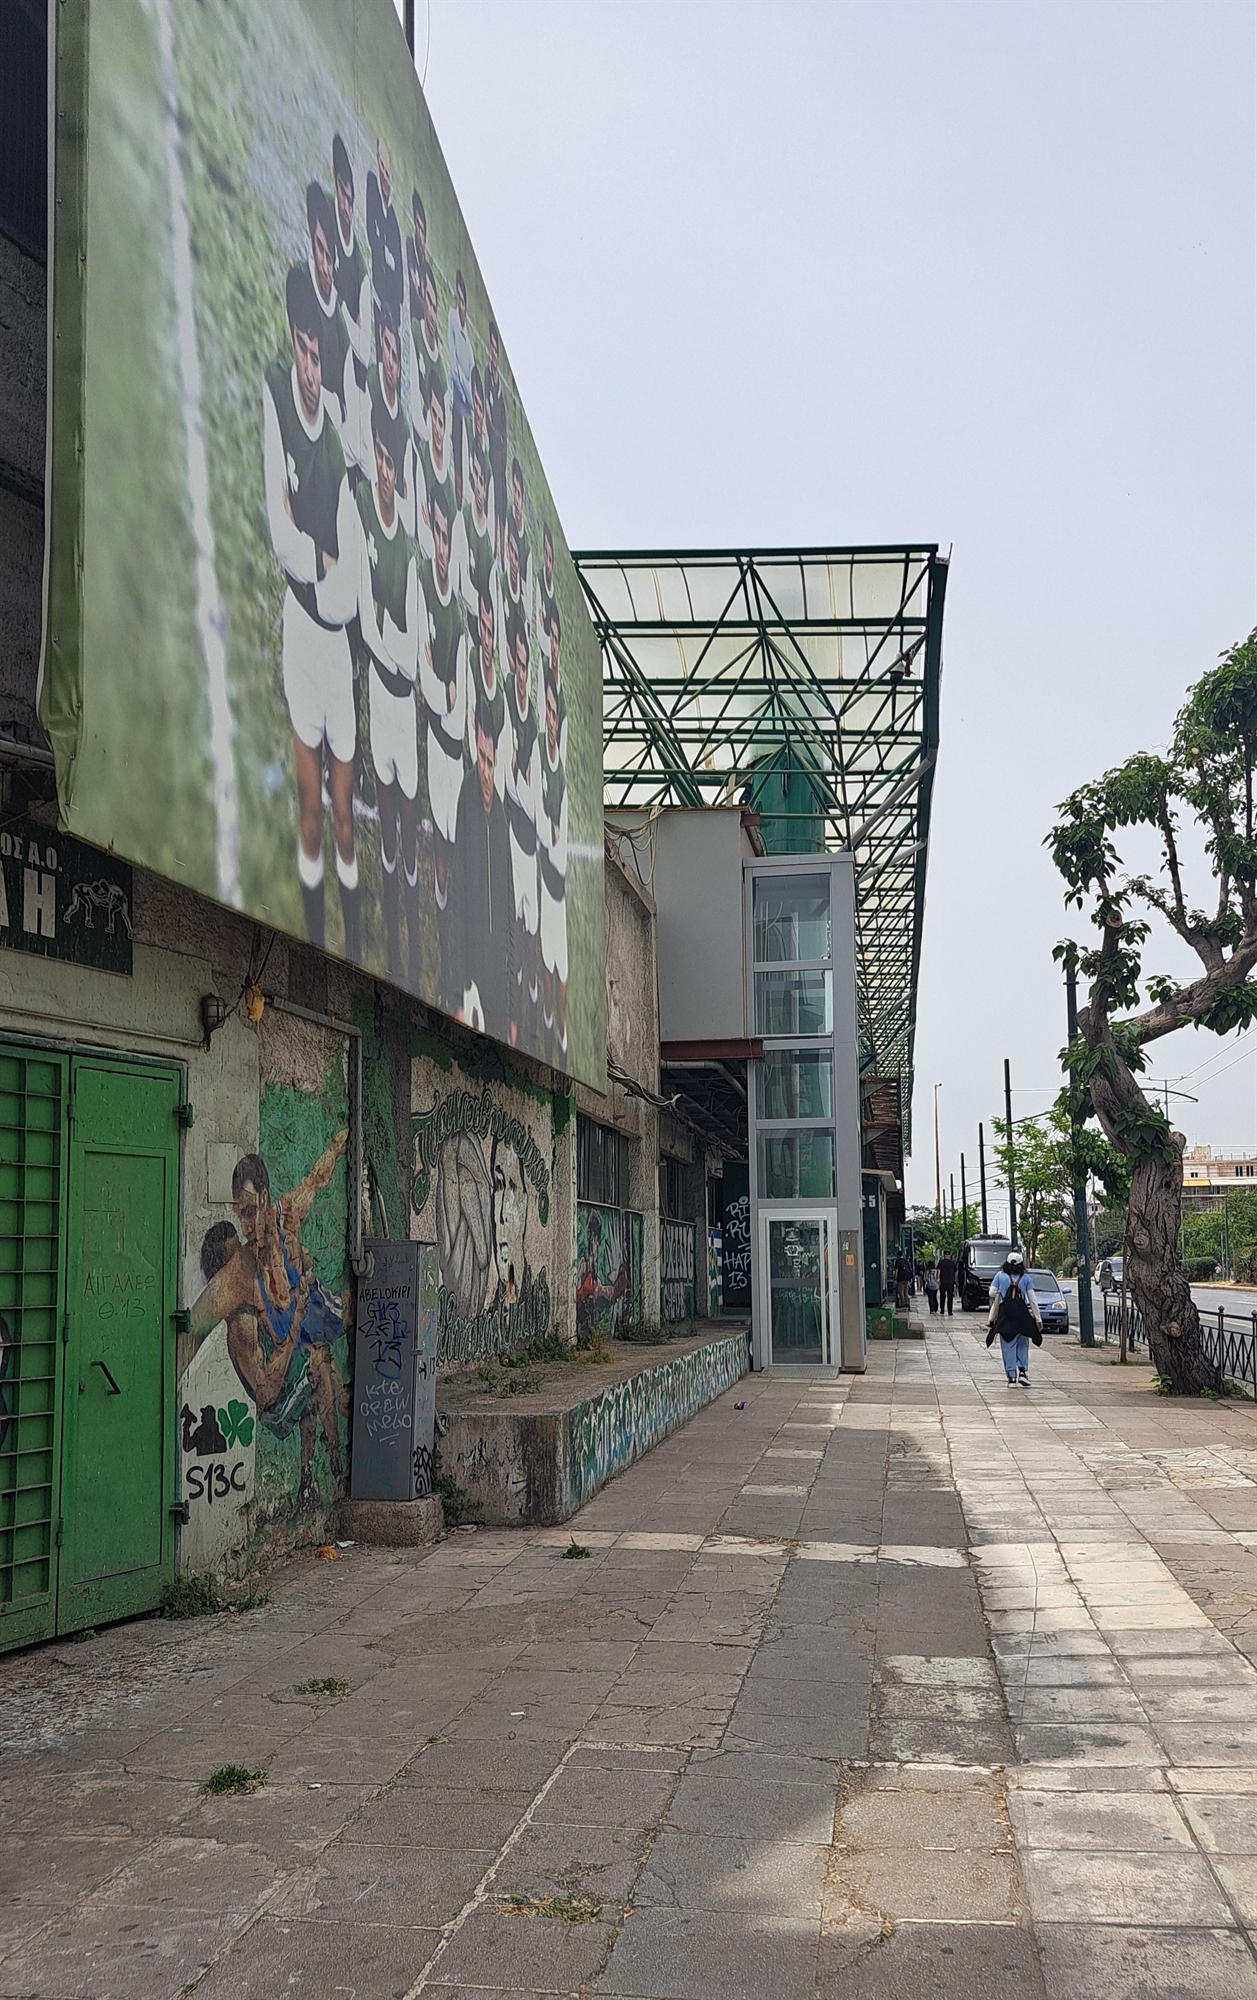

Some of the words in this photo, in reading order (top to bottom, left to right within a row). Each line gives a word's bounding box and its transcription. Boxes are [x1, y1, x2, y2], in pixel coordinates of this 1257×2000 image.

[28, 841, 63, 872] Α.Ο.
[728, 1271, 748, 1290] 13
[186, 1462, 246, 1504] S13C
